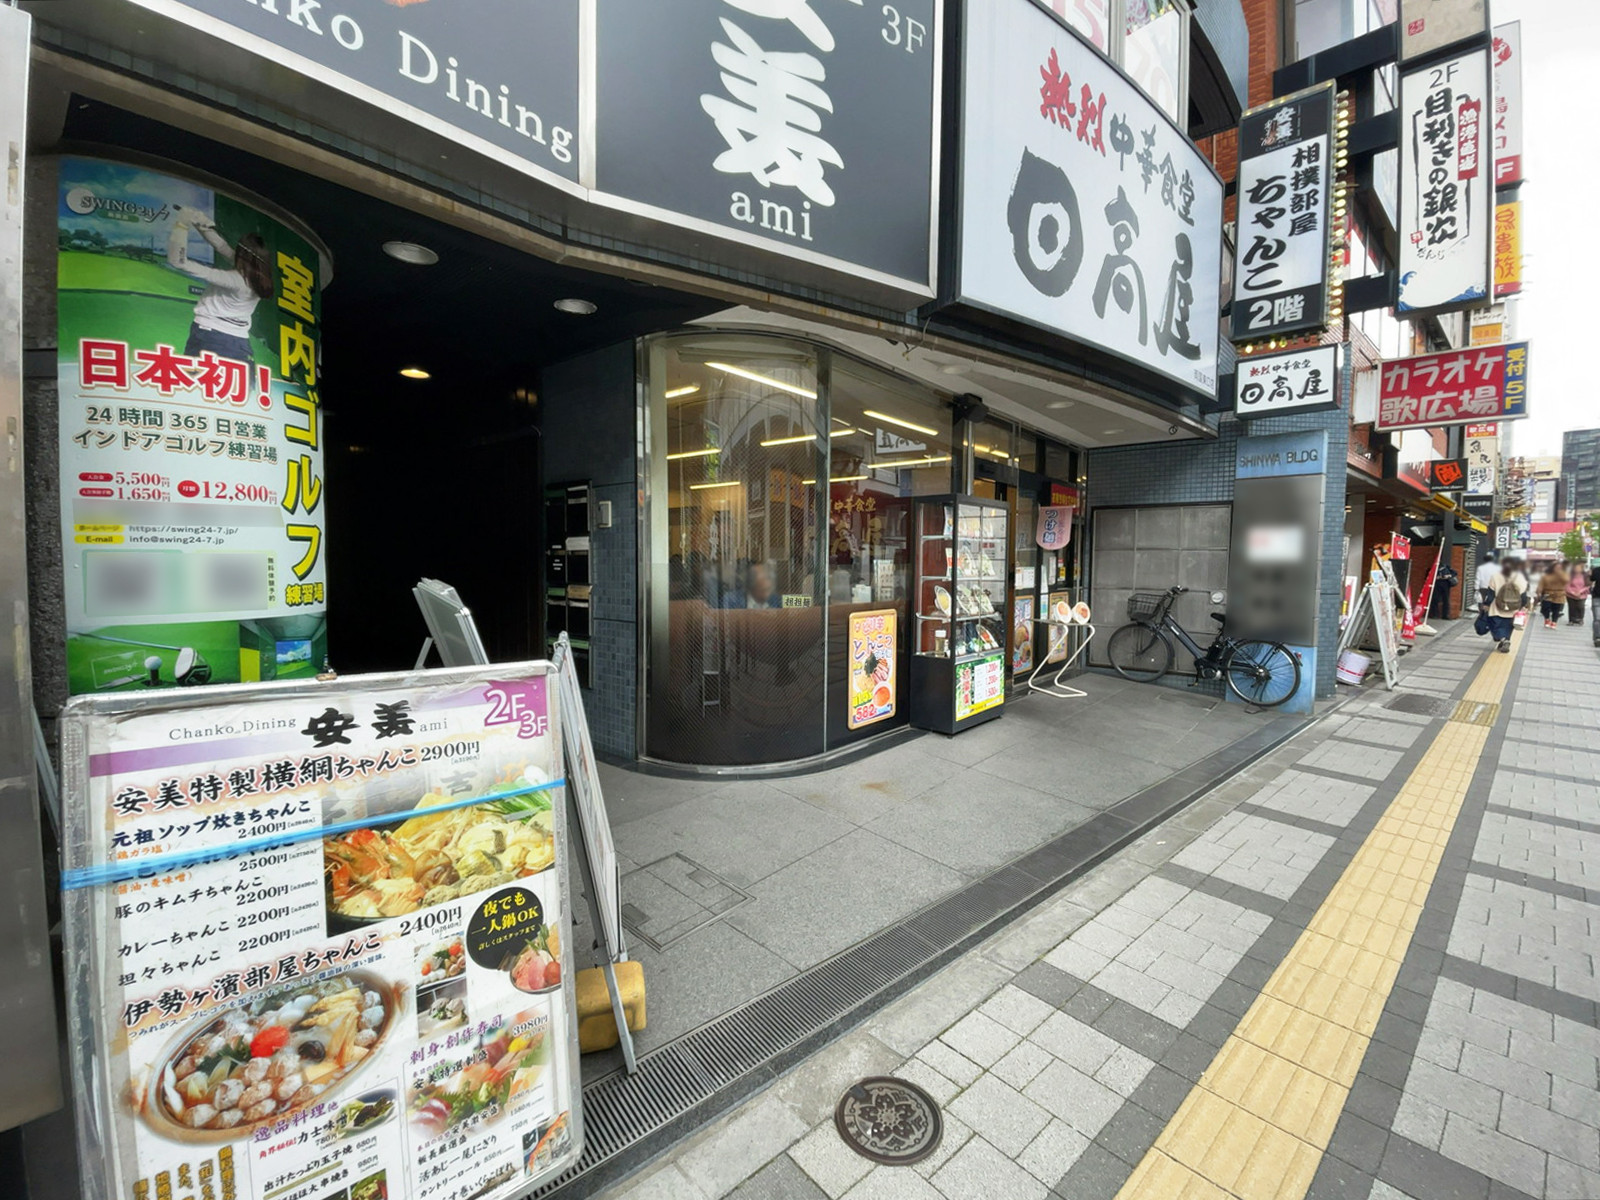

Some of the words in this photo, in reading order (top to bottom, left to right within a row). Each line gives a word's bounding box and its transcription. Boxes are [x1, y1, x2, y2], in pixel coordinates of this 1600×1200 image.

[881, 5, 926, 53] 3F
[1429, 61, 1460, 89] 2F
[398, 29, 573, 164] Dining
[1289, 143, 1320, 237] 相撲部屋
[730, 191, 813, 241] ami
[1243, 175, 1287, 291] ちゃんこ
[1007, 146, 1201, 360] 日高屋
[1248, 294, 1305, 330] 2階
[80, 339, 272, 409] 日本初!
[1240, 369, 1329, 404] 日高屋
[1384, 352, 1503, 392] カラオケ
[277, 251, 322, 581] 室内ゴルフ
[1381, 385, 1499, 424] 歌広場
[87, 406, 112, 423] 24
[118, 408, 164, 427] 時間
[170, 413, 208, 431] 365
[215, 418, 268, 441] 日営業
[74, 429, 278, 463] インドアゴルフ練習場
[1239, 452, 1282, 468] SHINWA
[1286, 448, 1318, 464] BLDG
[86, 535, 113, 543] E-mail
[129, 535, 225, 545] info@swing24-7.jp
[1497, 527, 1508, 548] SLOT
[485, 688, 526, 725] 2F
[519, 710, 548, 738] 3F
[169, 725, 235, 740] Chanko
[243, 718, 297, 733] Dining
[419, 718, 448, 733] ami
[113, 748, 417, 815] 安美特製横綱ちゃんこ
[421, 741, 480, 763] 2900円
[110, 800, 311, 848] 元祖ソップ炊きちゃんこ
[238, 820, 286, 839] 2400円
[239, 853, 288, 872] 2500円
[114, 876, 263, 920] 豚のキムチちゃんこ
[236, 884, 289, 906] 2200円
[482, 892, 526, 917] 夜でも
[117, 920, 230, 958] カレーちゃんこ
[237, 906, 290, 928] 2200円
[399, 906, 462, 936] 2400円
[471, 905, 539, 936] 一人鍋OK
[238, 929, 291, 952] 2200円
[513, 1016, 549, 1036] 3980円
